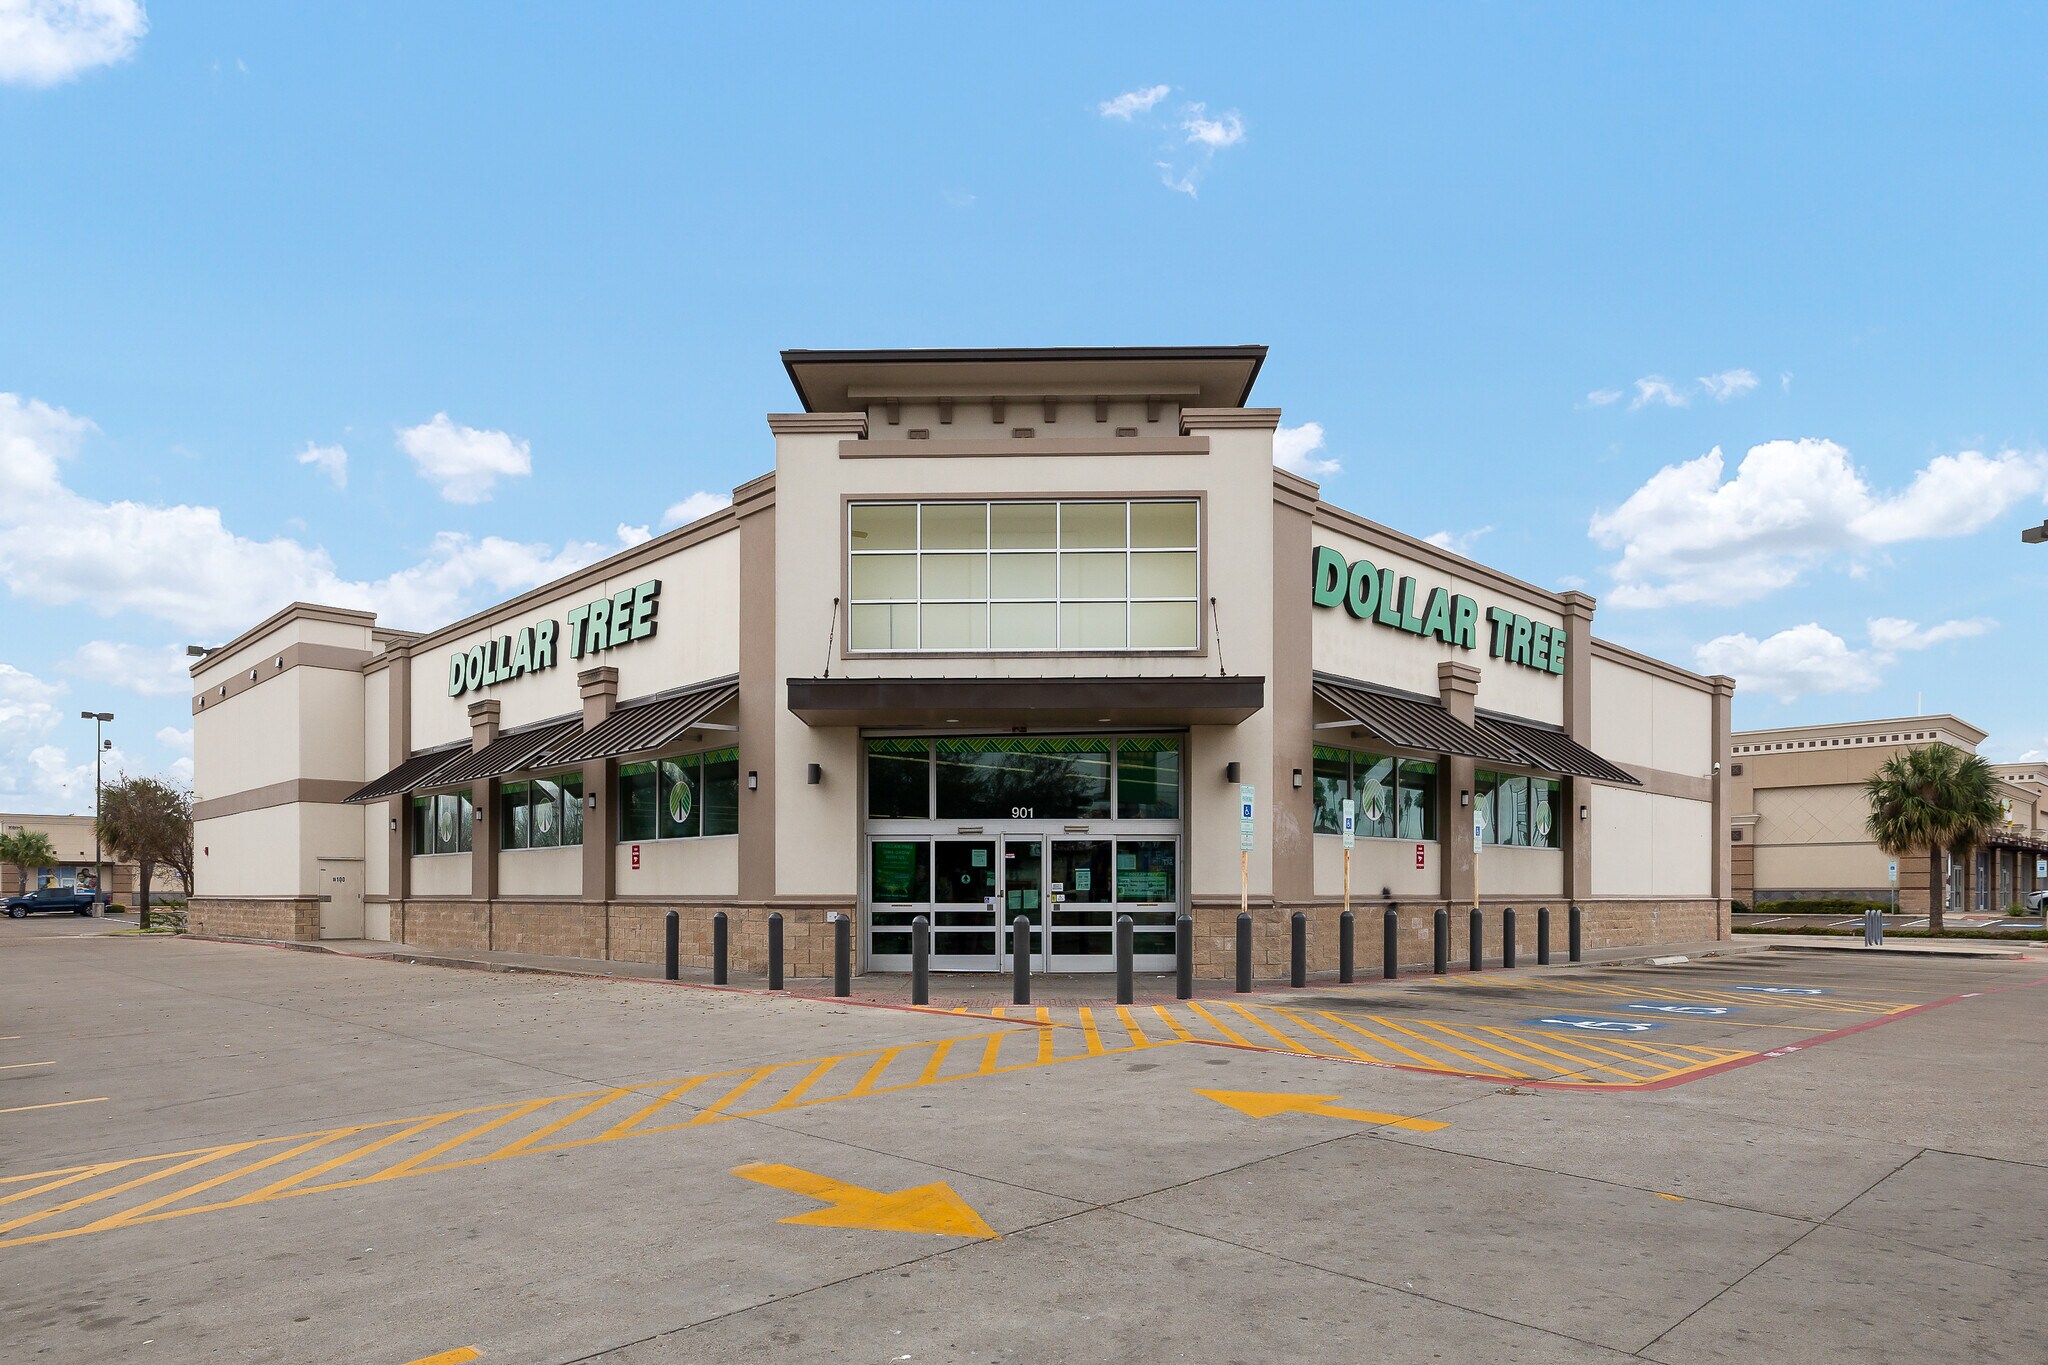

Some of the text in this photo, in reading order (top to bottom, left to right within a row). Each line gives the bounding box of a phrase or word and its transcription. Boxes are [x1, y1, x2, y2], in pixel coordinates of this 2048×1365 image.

[448, 579, 662, 698] DOLLAR TREE
[1312, 545, 1567, 676] DOLLAR TREE
[1011, 806, 1034, 819] 901
